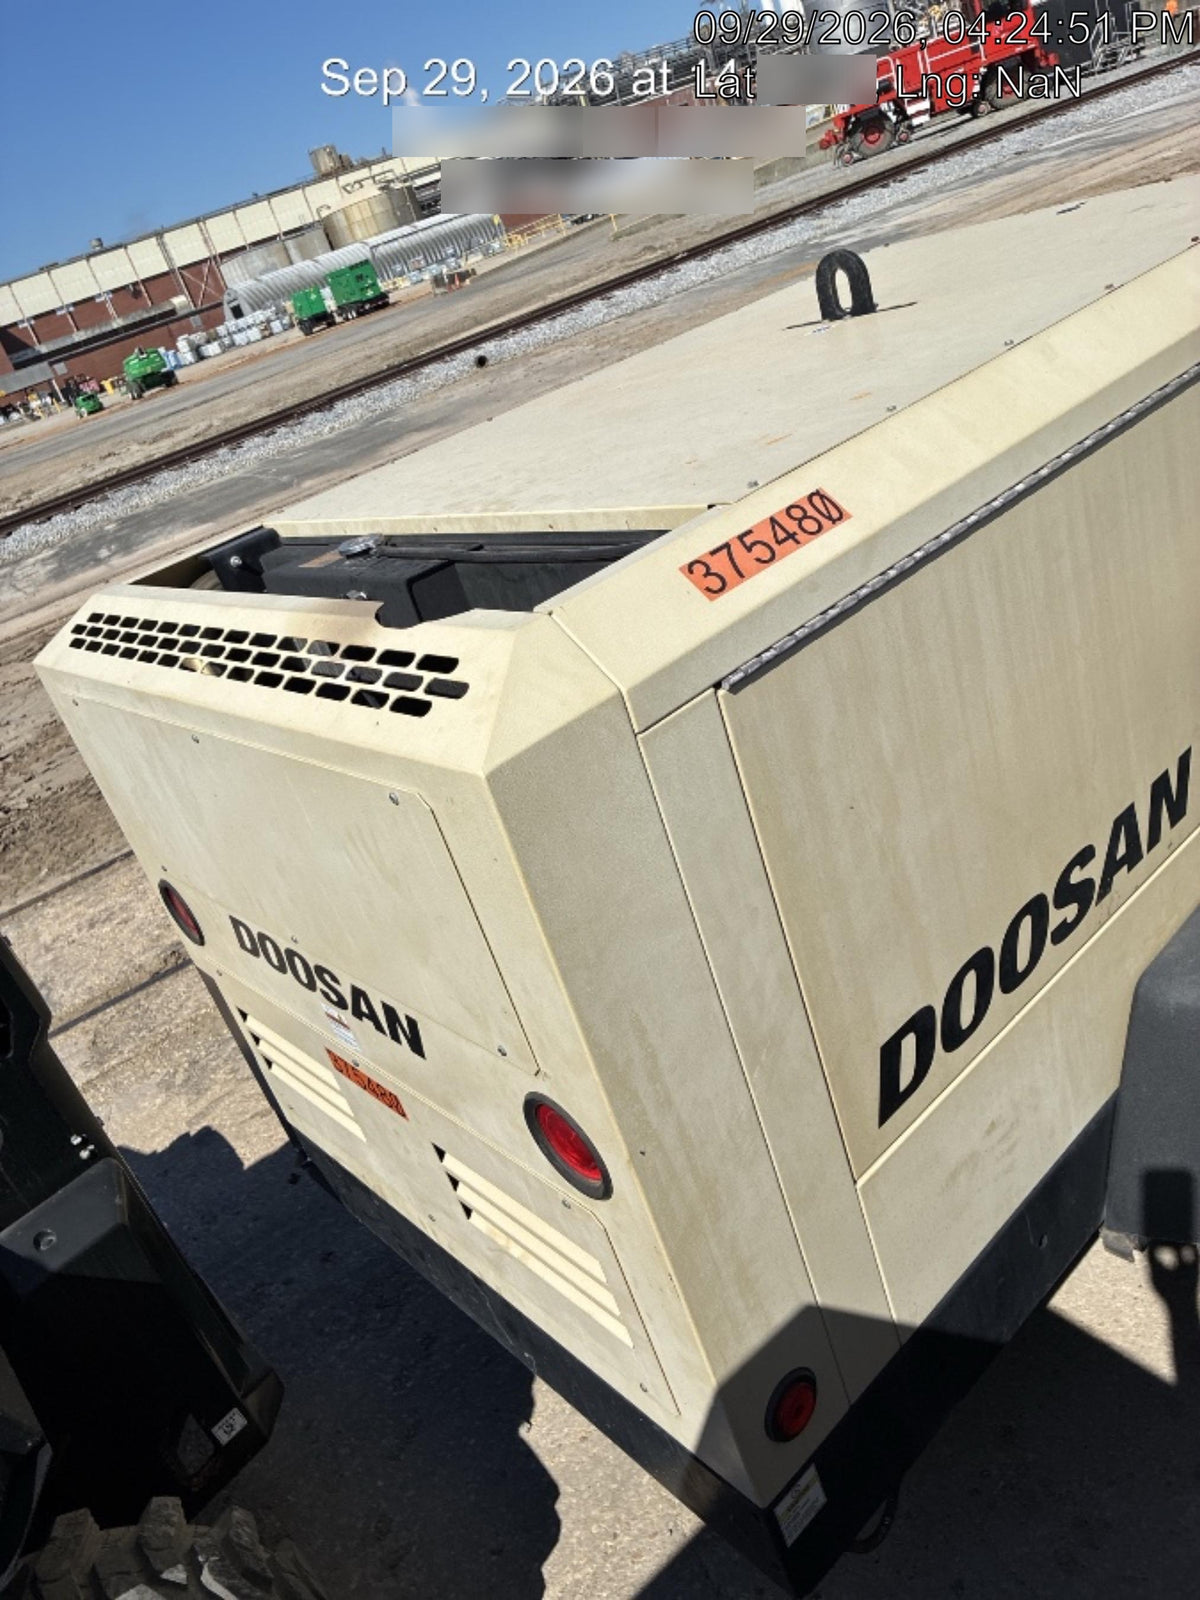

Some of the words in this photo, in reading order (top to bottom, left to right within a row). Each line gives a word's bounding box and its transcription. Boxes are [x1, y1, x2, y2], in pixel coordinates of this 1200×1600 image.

[687, 489, 844, 595] 375480
[229, 915, 426, 1060] DOOSAN
[878, 745, 1192, 1129] DOOSAN
